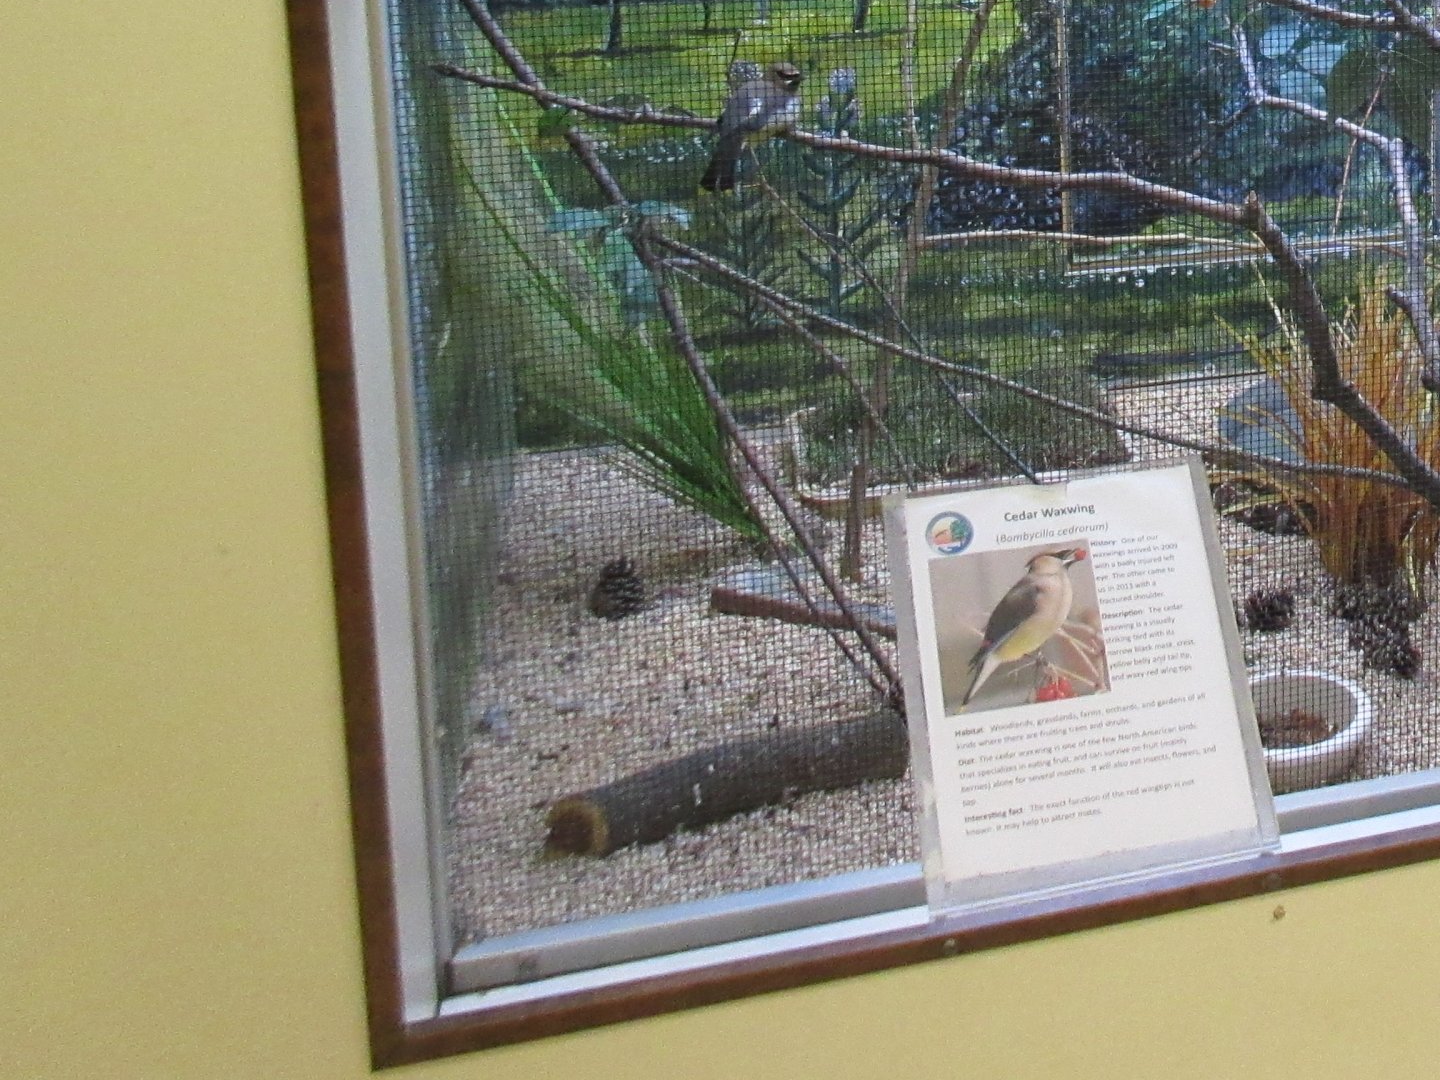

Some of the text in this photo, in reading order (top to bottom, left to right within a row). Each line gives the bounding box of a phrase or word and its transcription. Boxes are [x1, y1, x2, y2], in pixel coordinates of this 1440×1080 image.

[1003, 504, 1096, 522] Cedar Waxwing
[995, 521, 1109, 545] (Bombycilla cedrorum)
